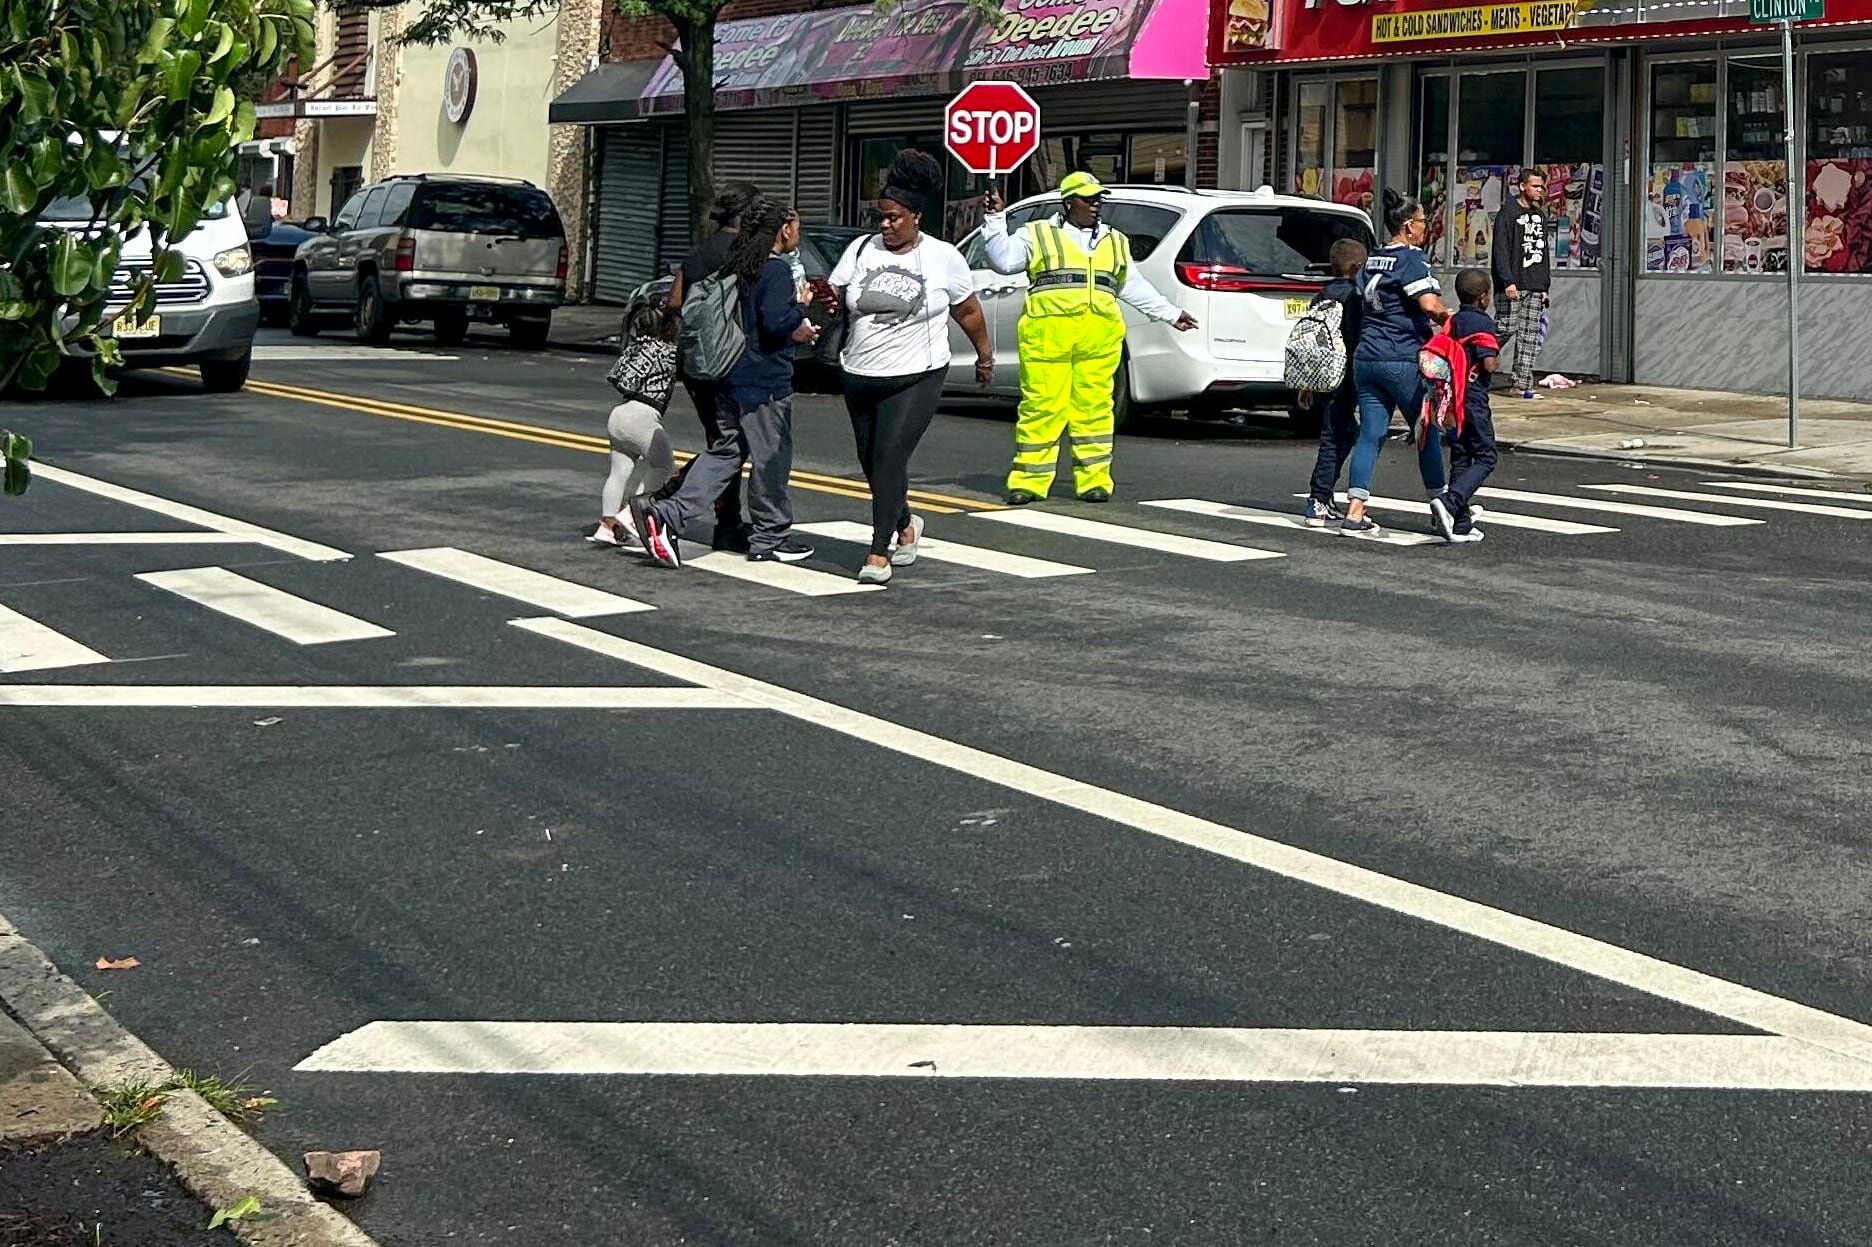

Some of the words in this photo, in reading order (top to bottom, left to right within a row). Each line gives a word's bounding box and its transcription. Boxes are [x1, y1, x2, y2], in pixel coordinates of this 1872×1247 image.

[988, 4, 1120, 45] Deedee
[1376, 15, 1392, 39] HOT
[1402, 14, 1424, 37] COLD
[1426, 10, 1483, 34] SANDWICHES
[1491, 7, 1521, 30] MEATS
[950, 109, 1034, 145] STOP
